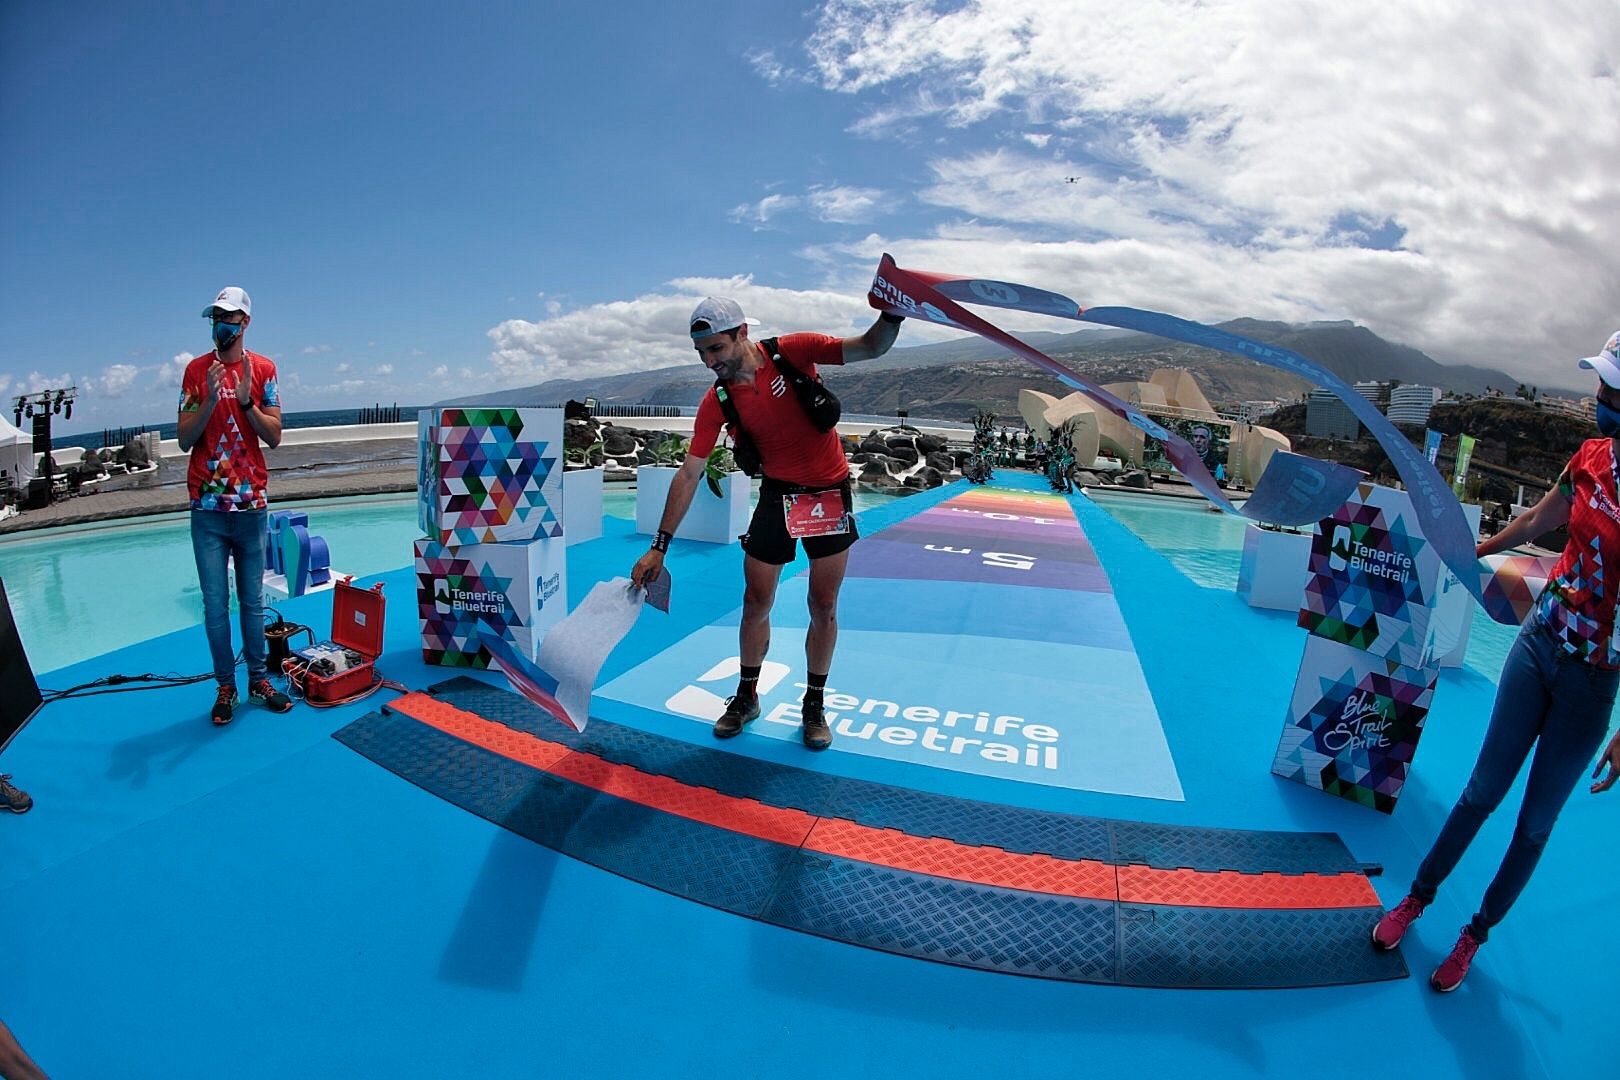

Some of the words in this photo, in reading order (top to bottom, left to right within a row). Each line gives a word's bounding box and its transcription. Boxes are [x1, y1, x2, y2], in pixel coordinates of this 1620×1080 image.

[811, 503, 824, 518] 4
[1353, 541, 1411, 569] Tenerife
[1351, 556, 1409, 583] Bluetrail
[452, 589, 504, 602] Tenerife
[452, 601, 505, 614] Bluetrail
[1341, 691, 1380, 720] Blue
[1349, 709, 1392, 735] Trail
[1323, 723, 1391, 757] Spirit
